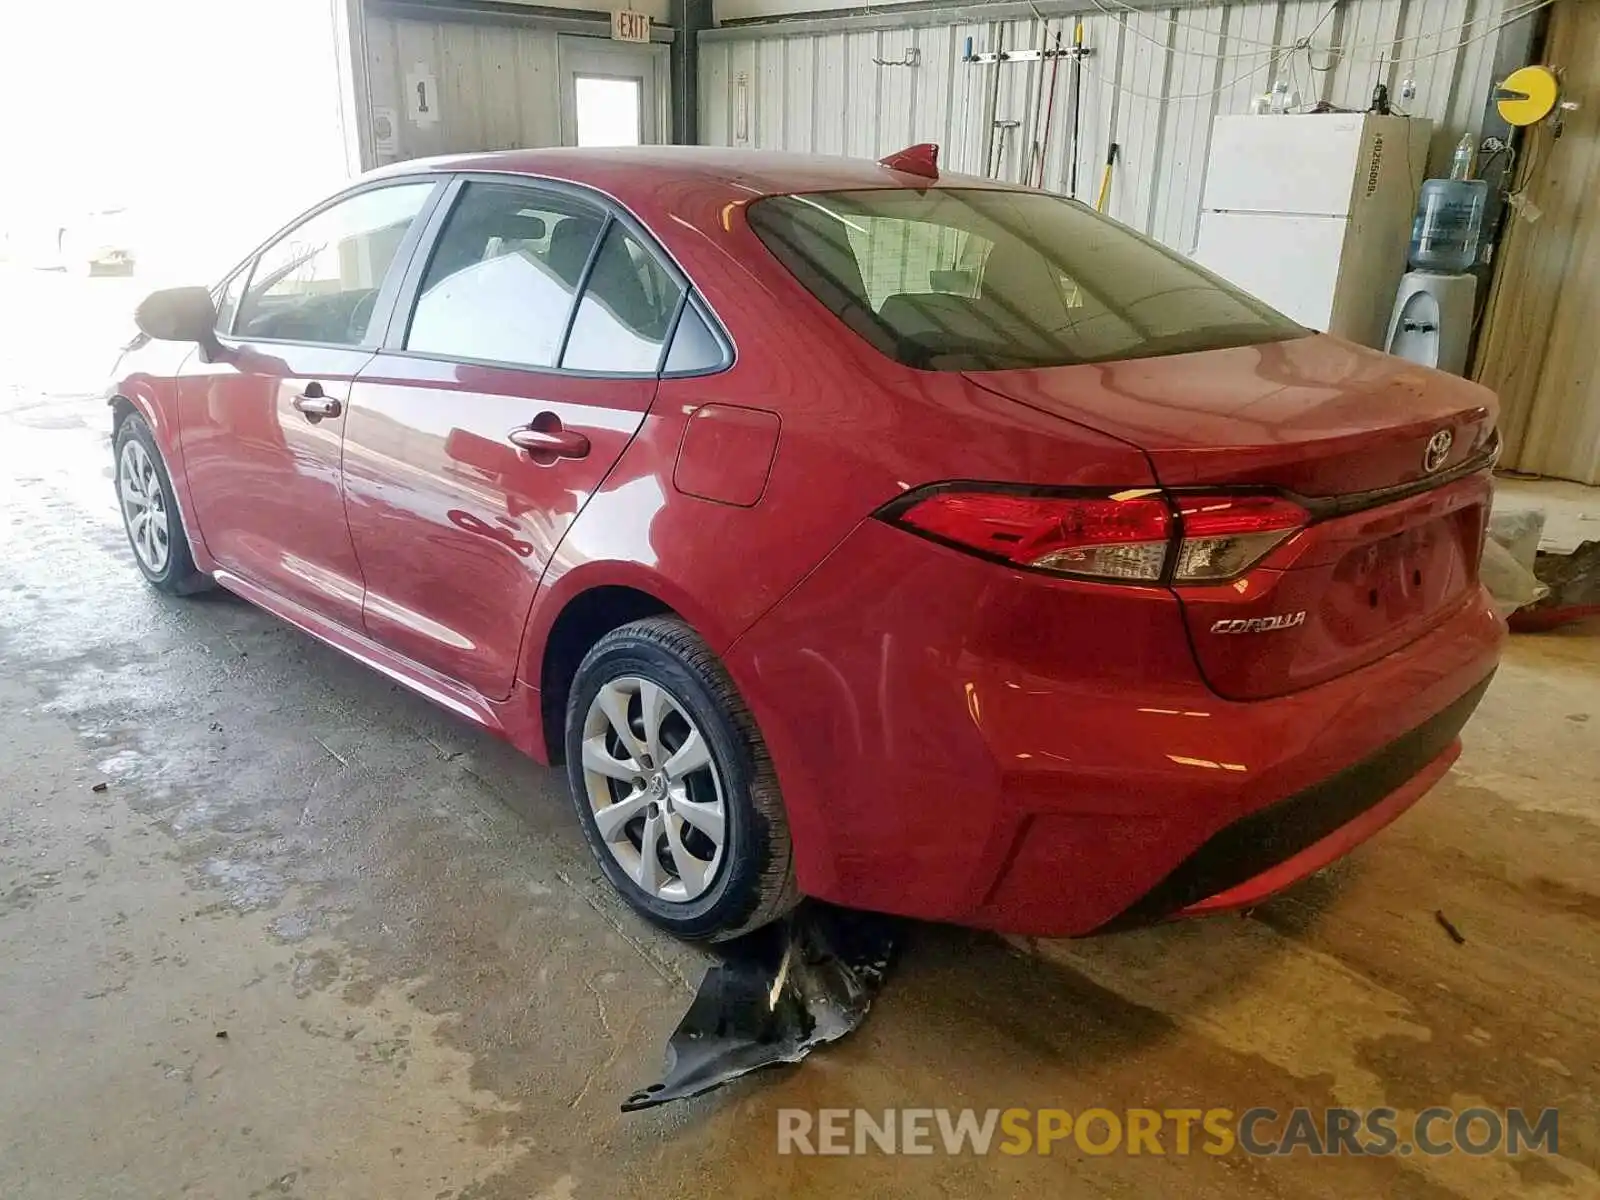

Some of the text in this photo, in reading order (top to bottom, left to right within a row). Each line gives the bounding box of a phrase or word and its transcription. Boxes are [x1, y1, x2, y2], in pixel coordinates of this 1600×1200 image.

[620, 12, 646, 39] EXIT
[416, 81, 430, 113] 1
[1209, 610, 1307, 634] COROLLA
